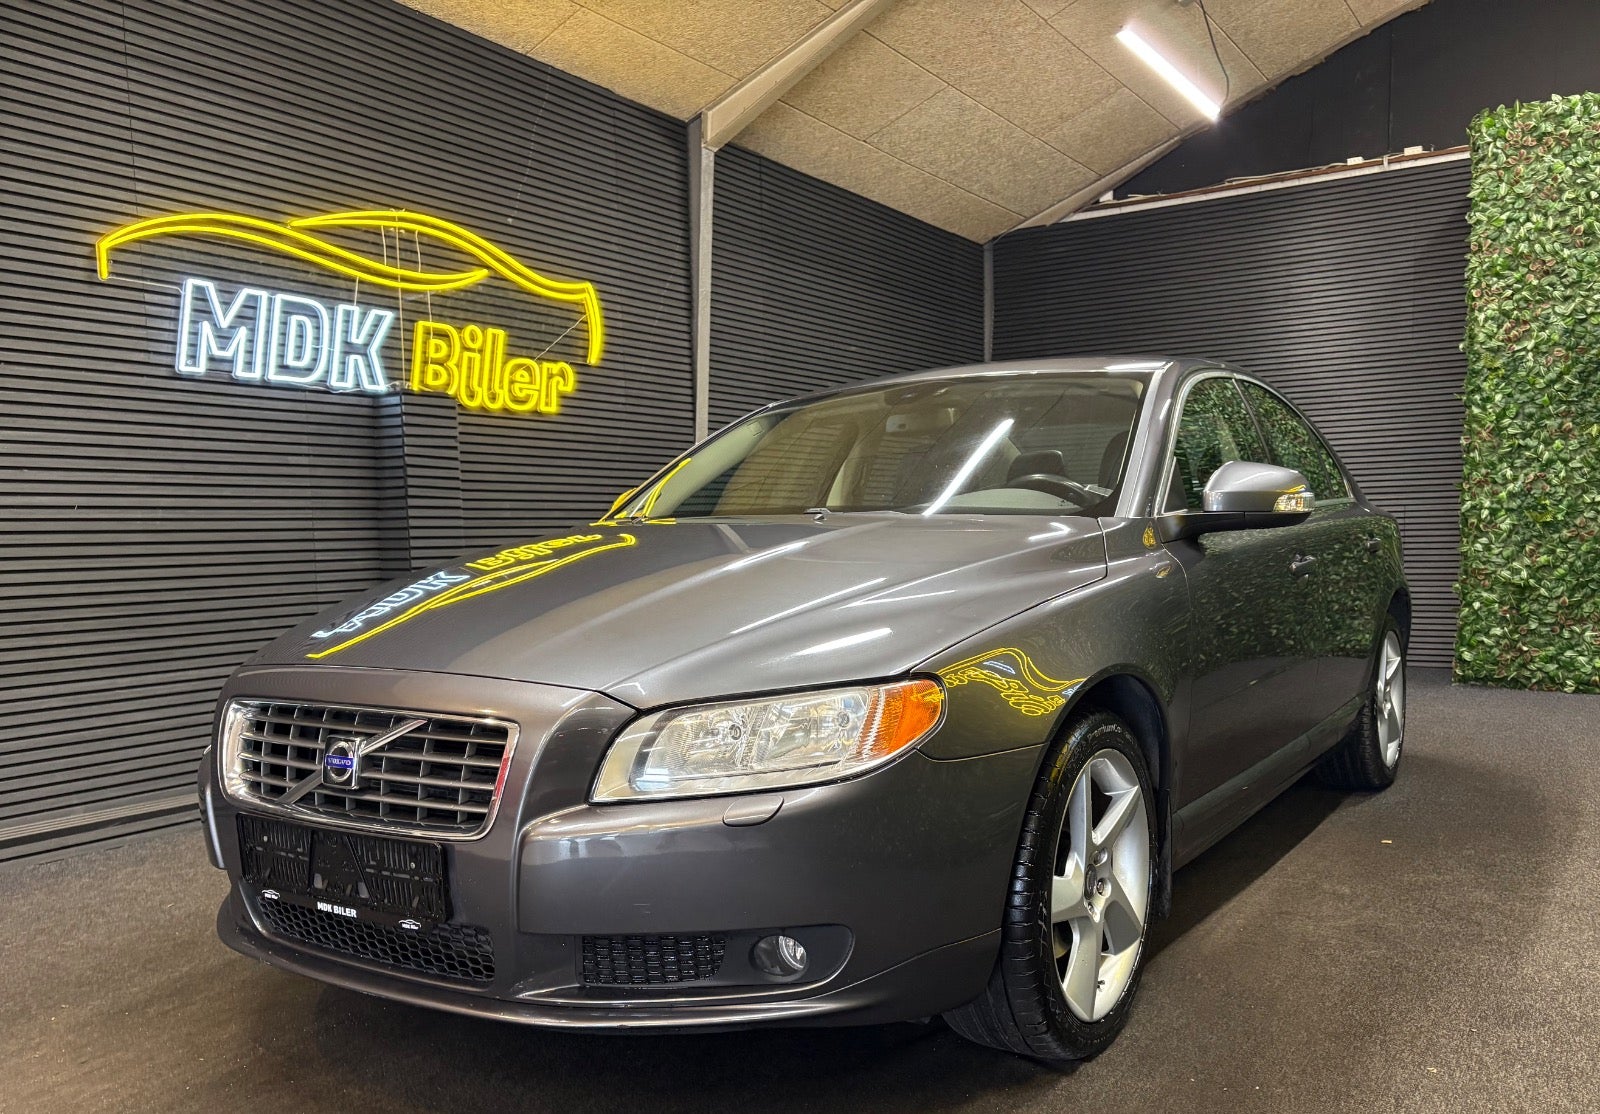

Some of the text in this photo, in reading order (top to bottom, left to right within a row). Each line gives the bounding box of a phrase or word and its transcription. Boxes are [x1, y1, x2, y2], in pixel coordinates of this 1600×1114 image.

[176, 278, 576, 414] MDK Biler
[327, 756, 352, 767] VOLVO
[317, 901, 357, 918] MDK BILER
